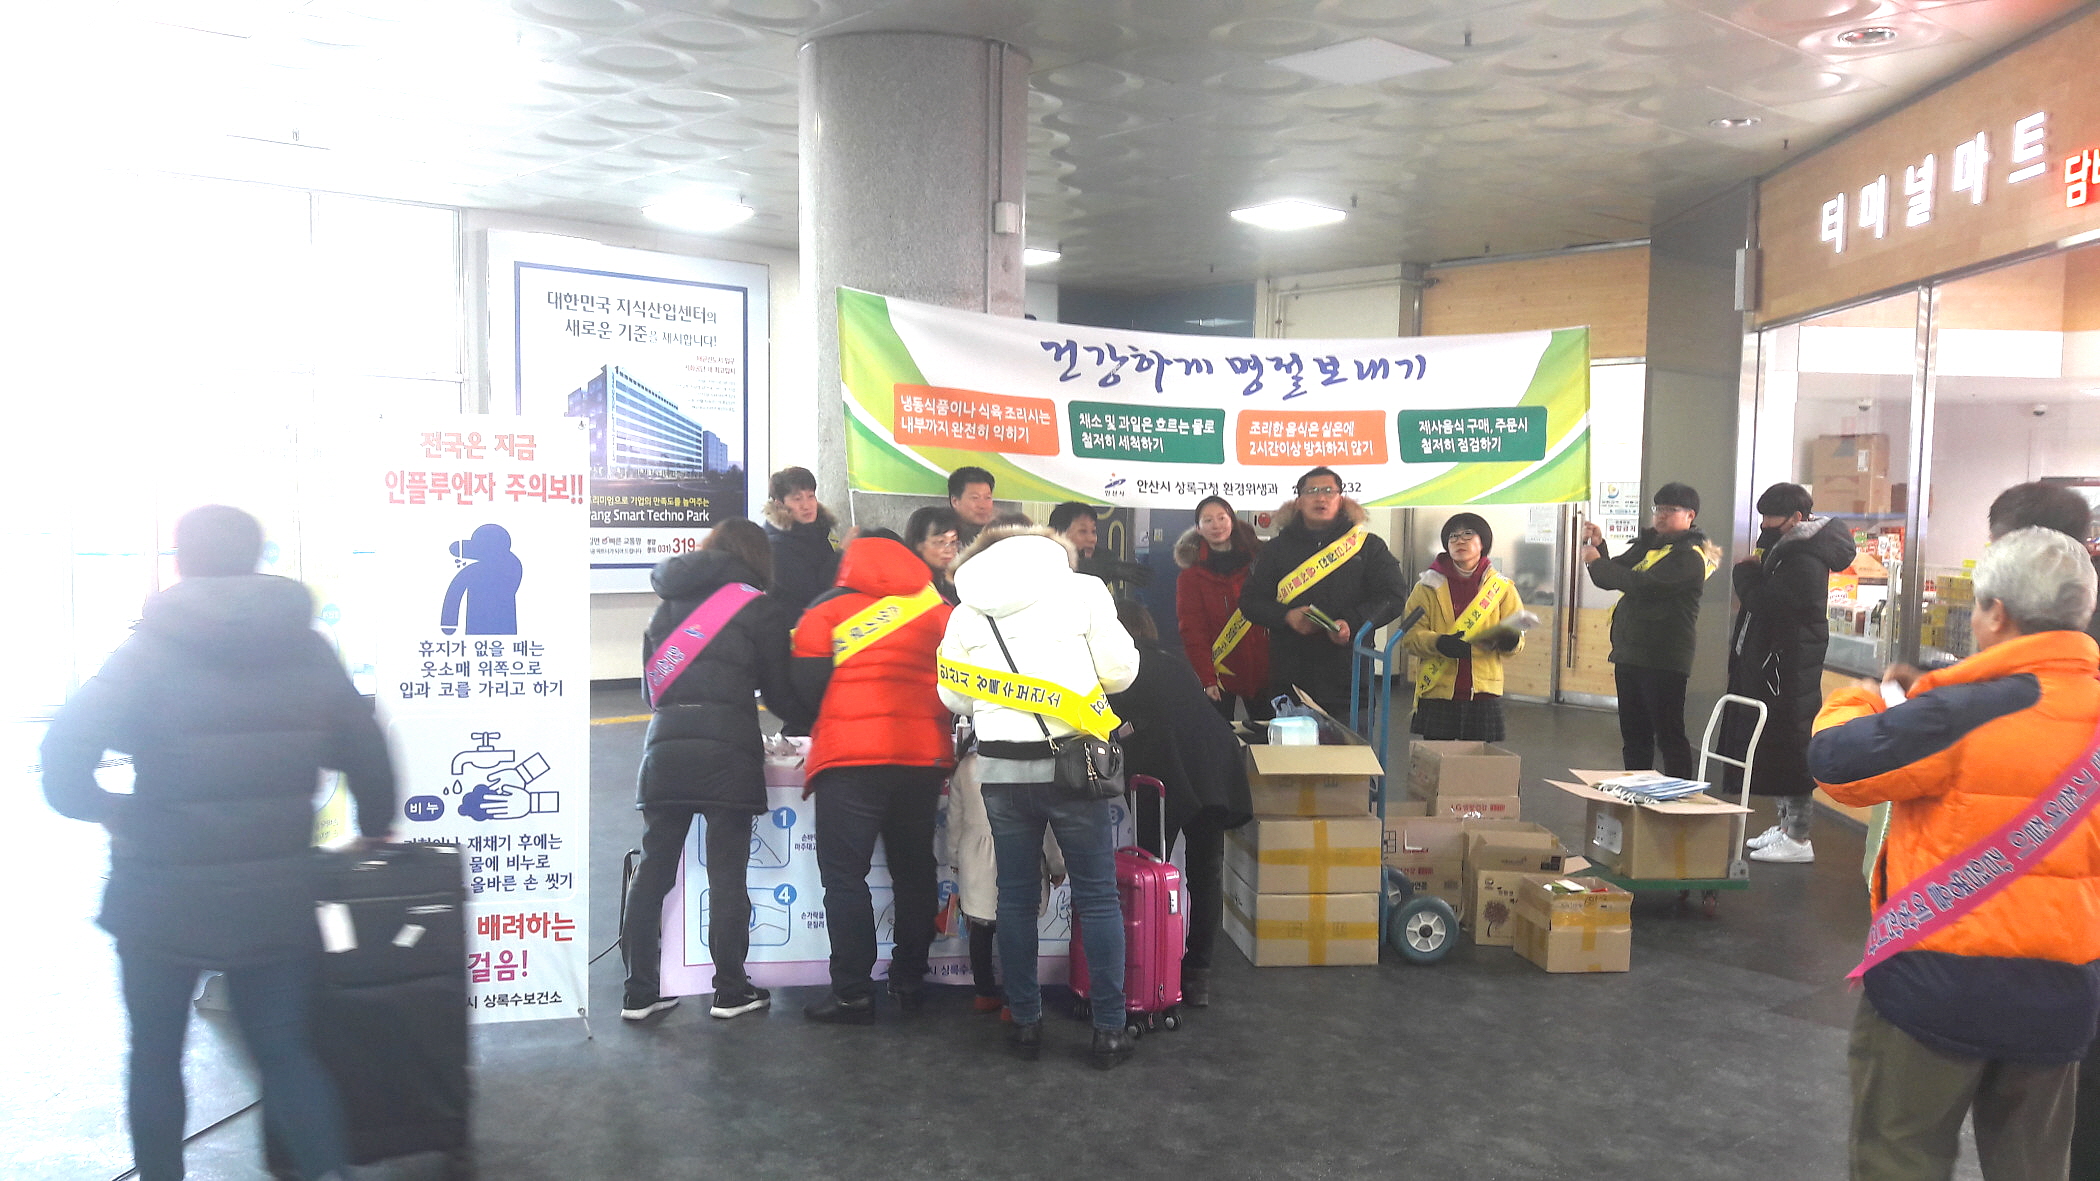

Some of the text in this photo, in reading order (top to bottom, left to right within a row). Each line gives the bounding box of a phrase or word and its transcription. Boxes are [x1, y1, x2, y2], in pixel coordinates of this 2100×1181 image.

[1821, 111, 2100, 253] 터미널마트 담
[547, 291, 717, 324] 대한민국 지식산업센터의
[565, 318, 612, 340] 새로운
[1041, 339, 1214, 393] 건강하게
[900, 395, 1051, 425] 냉동식품이나 식육 조리시는
[901, 417, 1030, 444] 내부까지 완전히 익히기
[1079, 412, 1216, 435] 채소 및 과일은 흐르는 물로
[1249, 420, 1355, 438] 조리한 음식은 실온에
[1419, 419, 1465, 435] 제사음식
[1495, 417, 1529, 434] 주문시
[420, 431, 537, 461] 전국은 지금
[1082, 431, 1164, 454] 철저히 세척하기
[1249, 440, 1373, 457] 2시간이상 방치하지 않기
[1421, 437, 1502, 455] 철저히 점검하기
[385, 470, 583, 505] 인플루엔자 주의보!!
[1137, 479, 1171, 494] 안산시
[1175, 481, 1219, 496] 상록구청
[1223, 482, 1279, 496] 환경위생과
[590, 509, 710, 524] ang Smart Techno Park
[418, 639, 545, 658] 휴지가 없을 때는
[420, 660, 543, 678] 옷소매 위쪽으로
[400, 680, 563, 699] 입과 코를 가리고 하기
[409, 801, 439, 816] 비누
[779, 809, 788, 827] 1
[467, 834, 511, 852] 재채기
[518, 833, 562, 851] 후에는
[469, 854, 550, 873] 물에 비누로
[470, 872, 573, 894] 올바른 손 씻기
[778, 886, 791, 903] 4
[477, 912, 576, 941] 배려하는
[483, 991, 562, 1008] 상록수보건소
